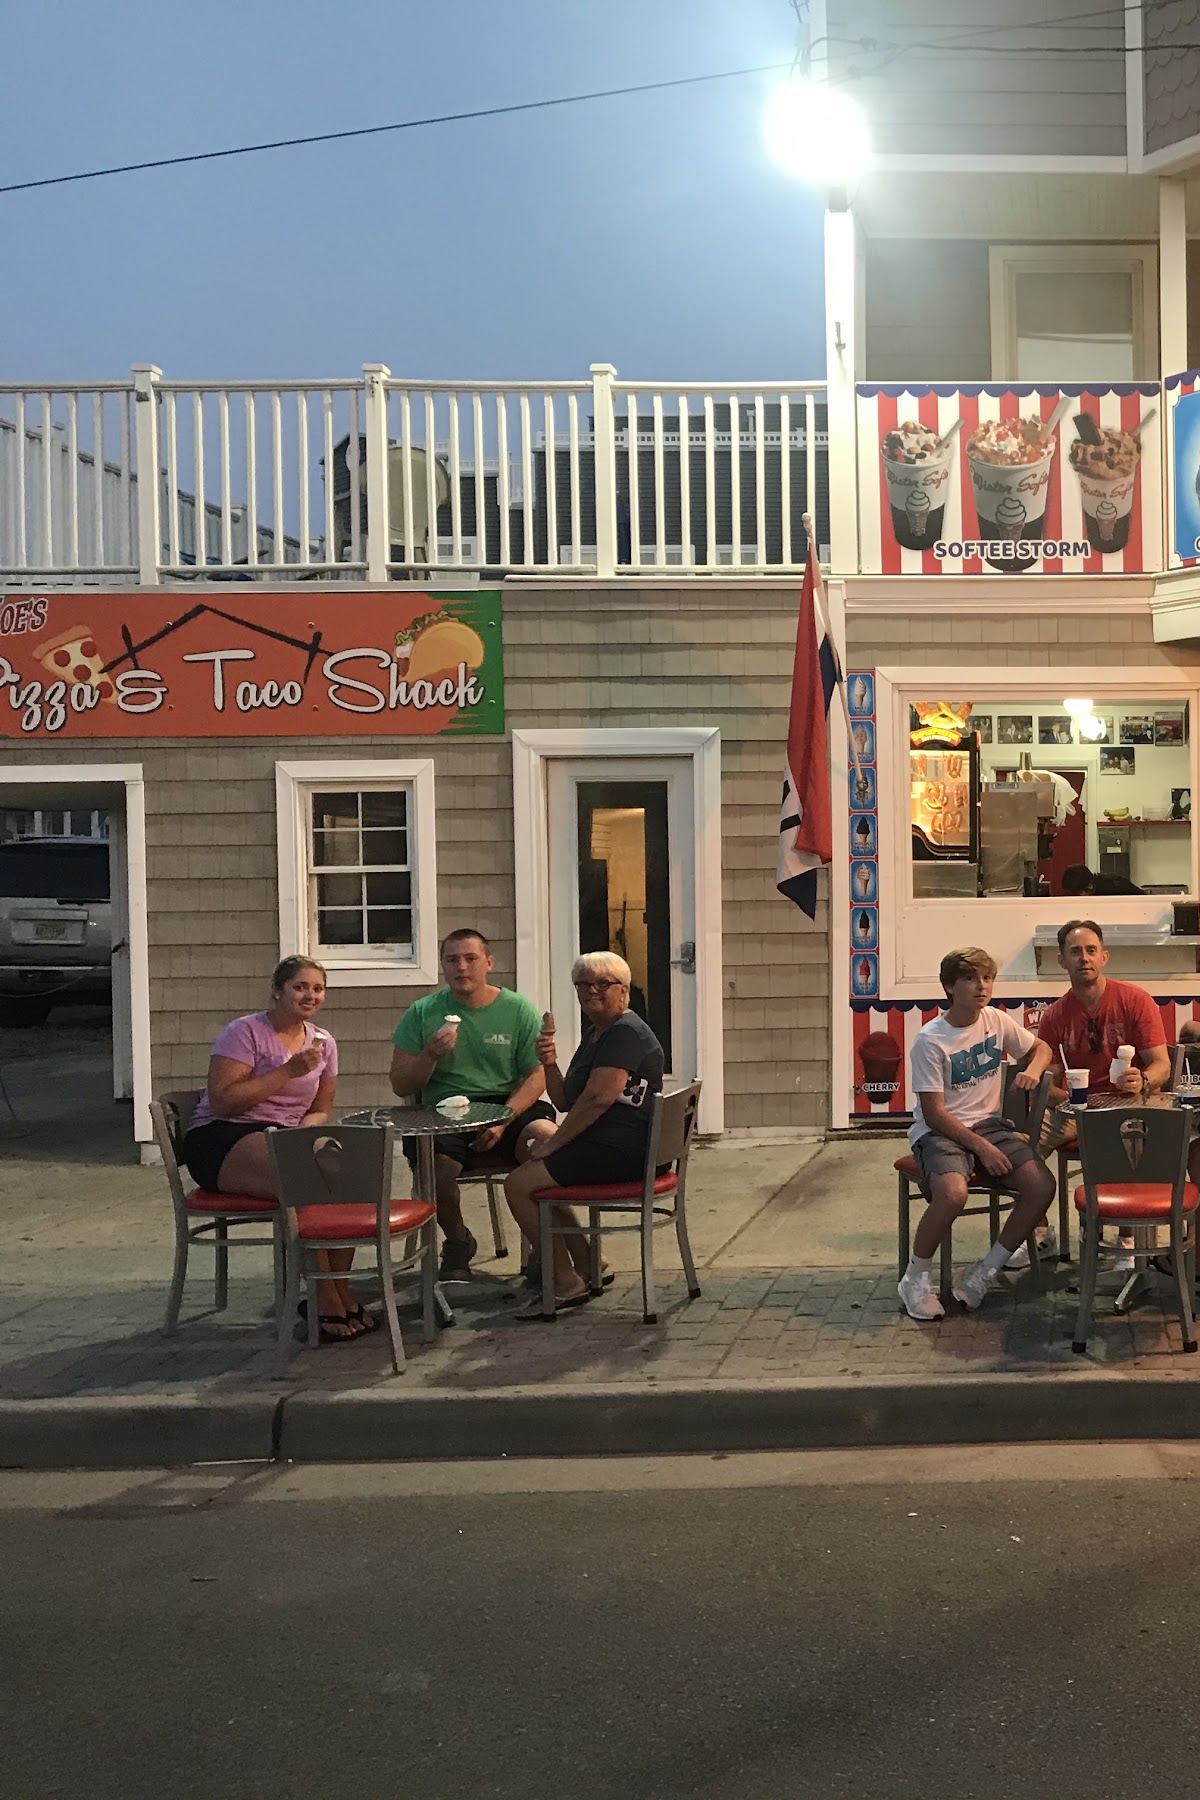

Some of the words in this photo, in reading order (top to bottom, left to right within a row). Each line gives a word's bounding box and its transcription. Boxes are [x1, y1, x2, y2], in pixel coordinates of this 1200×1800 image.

[934, 541, 1014, 558] SOFTEE
[1017, 541, 1090, 558] STORM
[0, 597, 48, 636] OE'S
[115, 669, 168, 713] &
[182, 650, 303, 711] Taco
[322, 647, 484, 713] Shack
[863, 1083, 899, 1091] CHERRY
